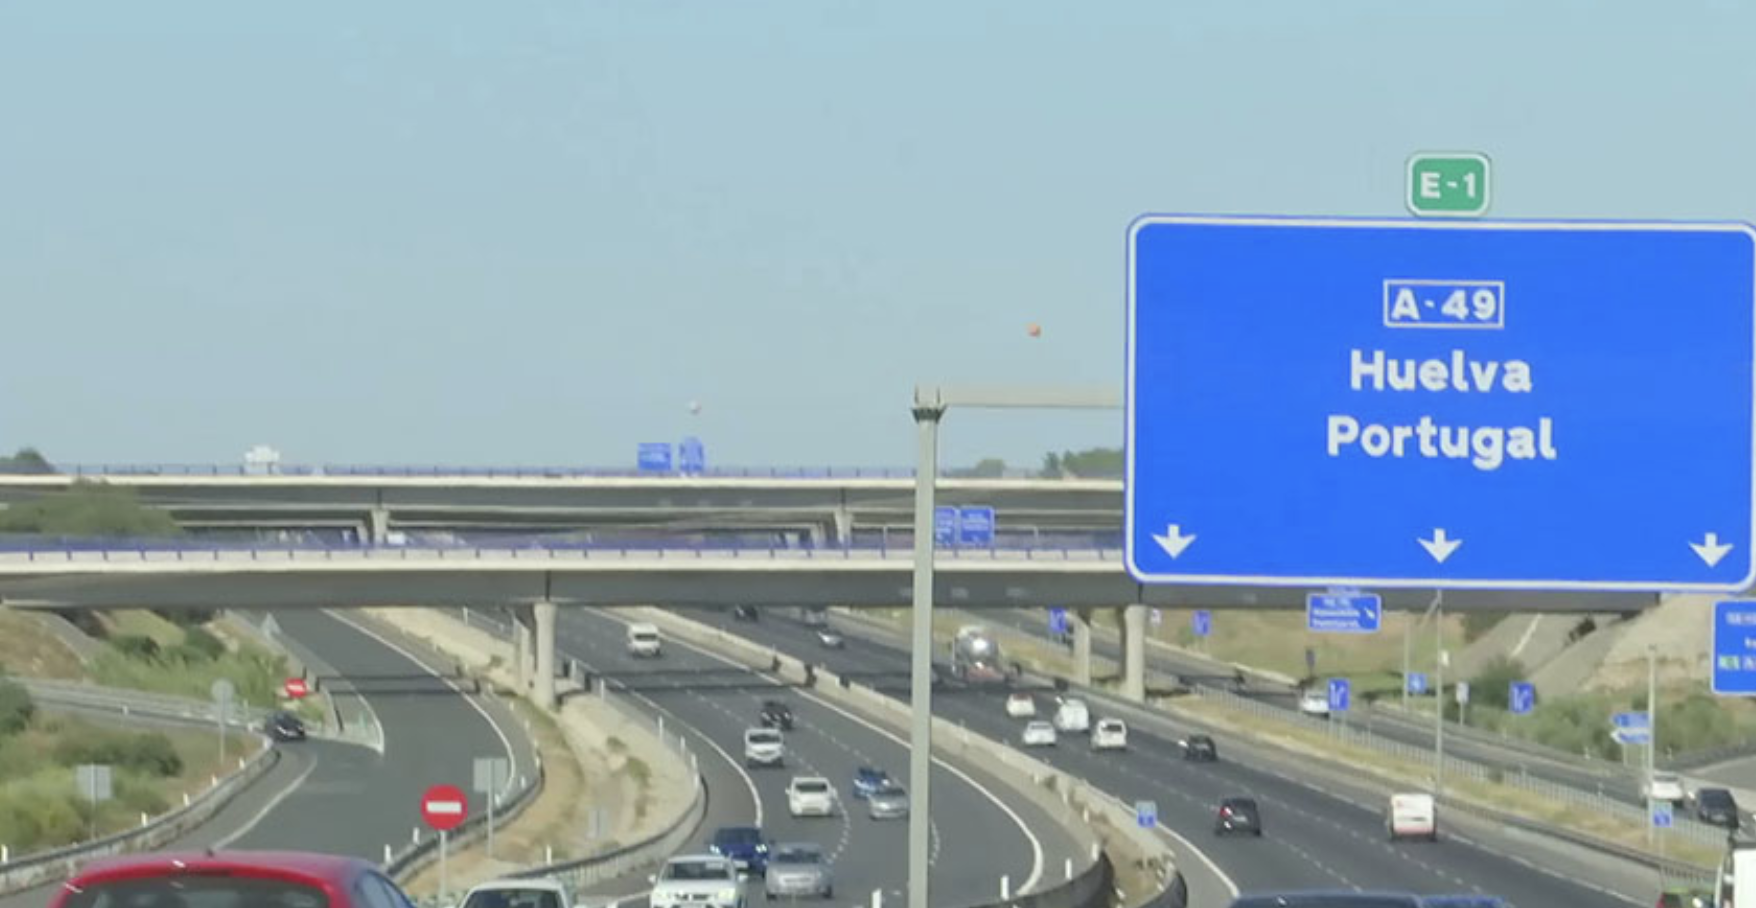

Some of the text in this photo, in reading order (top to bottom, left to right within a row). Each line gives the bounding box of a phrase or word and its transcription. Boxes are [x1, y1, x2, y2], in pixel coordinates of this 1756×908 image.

[1420, 171, 1476, 199] E-1
[1391, 288, 1496, 320] A-49
[1350, 350, 1532, 392] Huelva
[1327, 416, 1556, 470] Portugal
